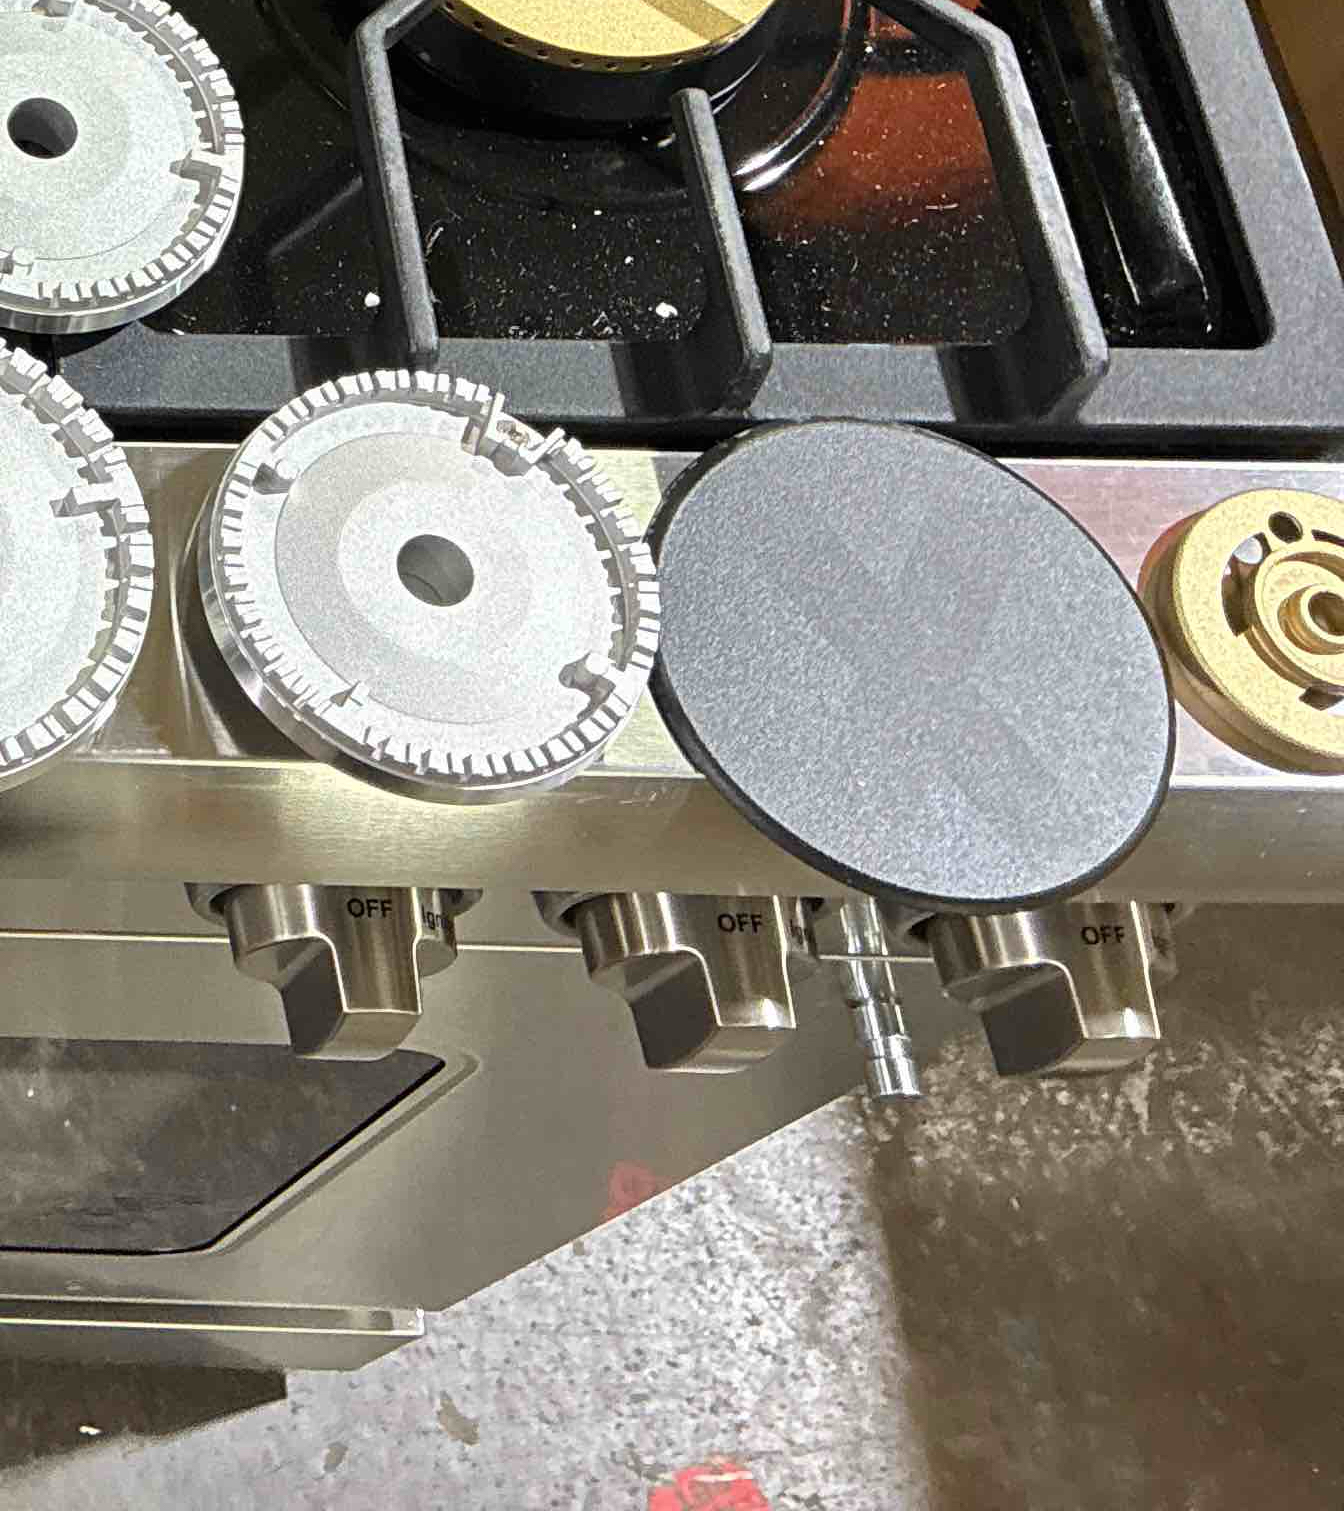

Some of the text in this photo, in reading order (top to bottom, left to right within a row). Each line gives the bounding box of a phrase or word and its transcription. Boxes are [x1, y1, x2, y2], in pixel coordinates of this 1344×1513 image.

[346, 897, 393, 918] OFF
[716, 912, 763, 935] OFF
[1079, 925, 1126, 946] OFF
